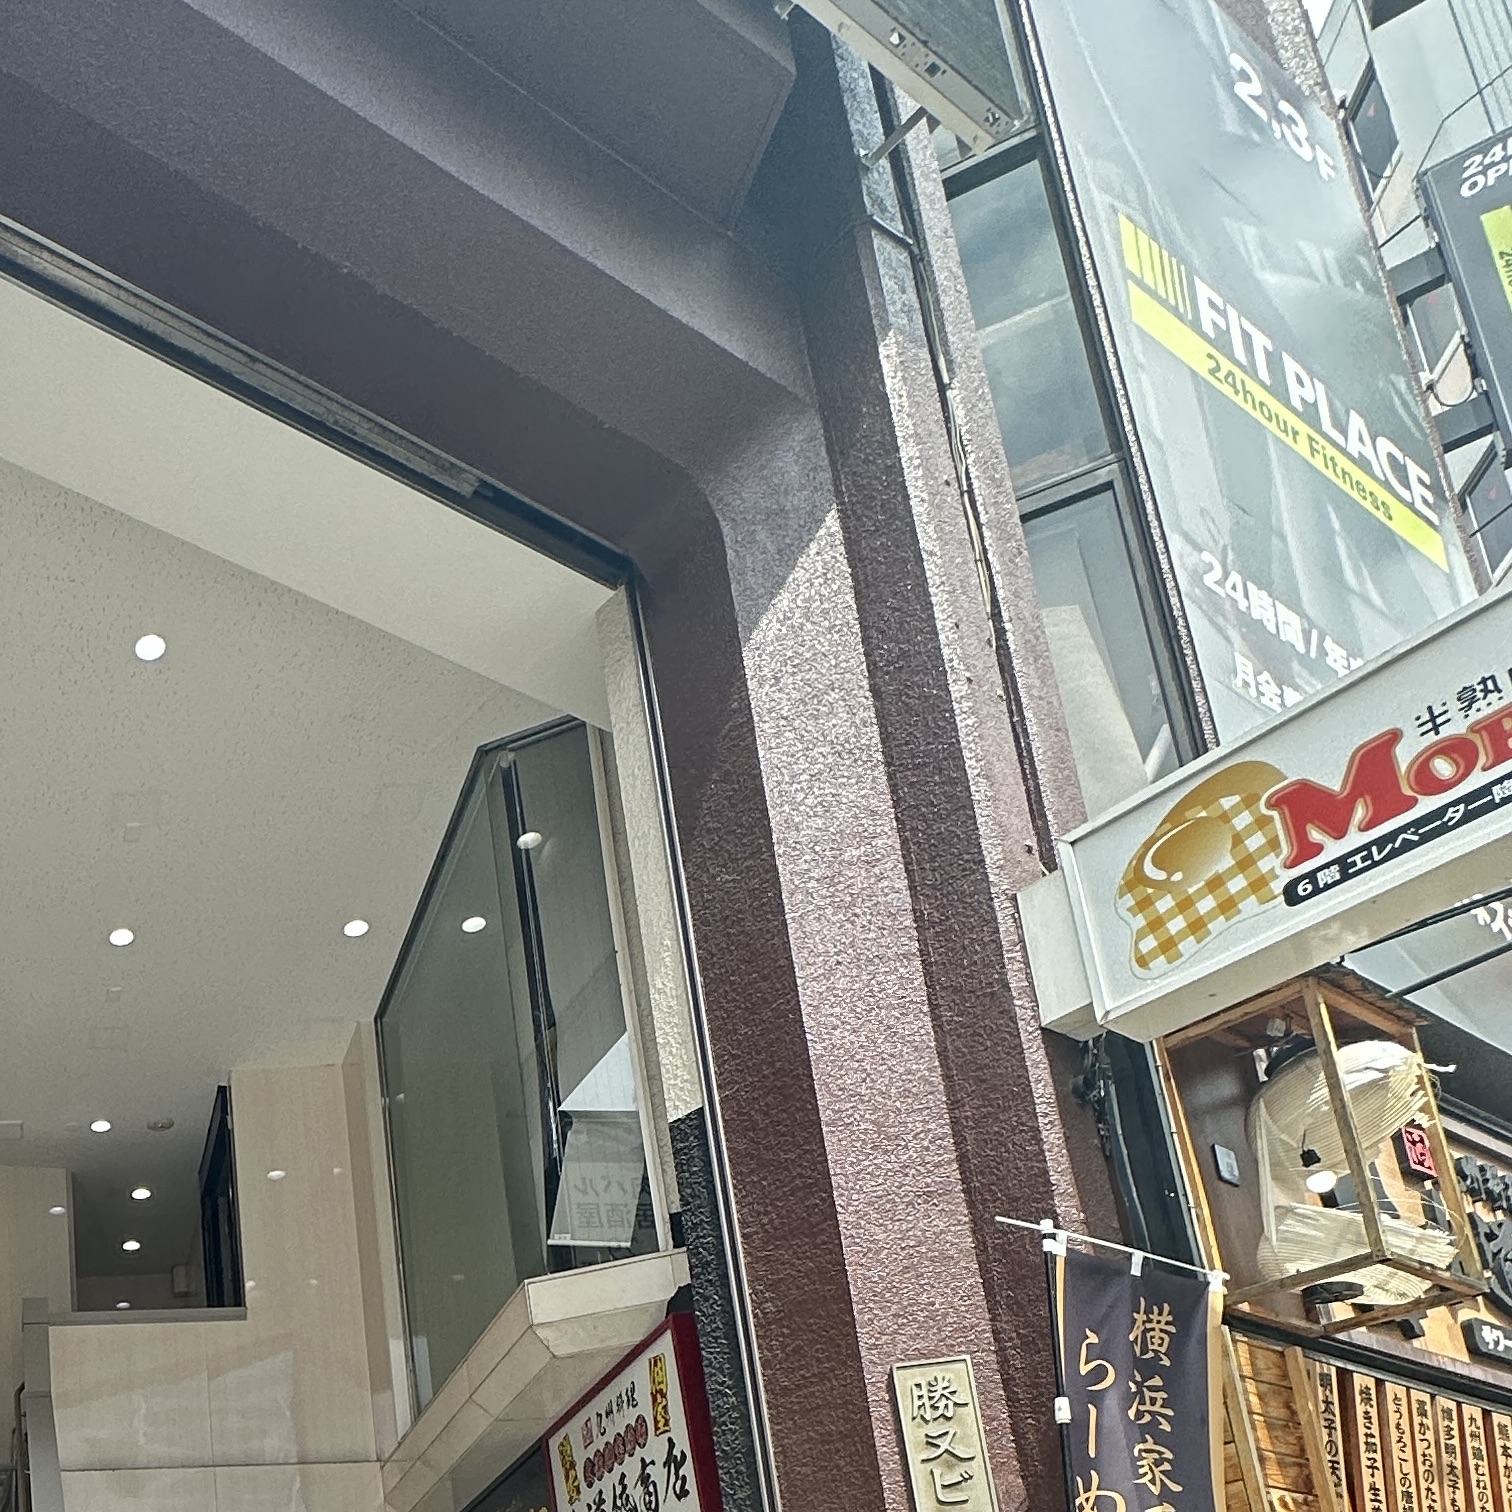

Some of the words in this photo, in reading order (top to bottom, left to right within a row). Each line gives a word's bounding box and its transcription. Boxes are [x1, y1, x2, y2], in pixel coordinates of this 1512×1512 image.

[1460, 159, 1512, 198] OP
[1194, 275, 1273, 386] FIT
[1281, 352, 1440, 526] PLACE
[1205, 352, 1300, 446] 24hour
[1308, 432, 1394, 523] Fitness
[1416, 668, 1512, 736] 半熟
